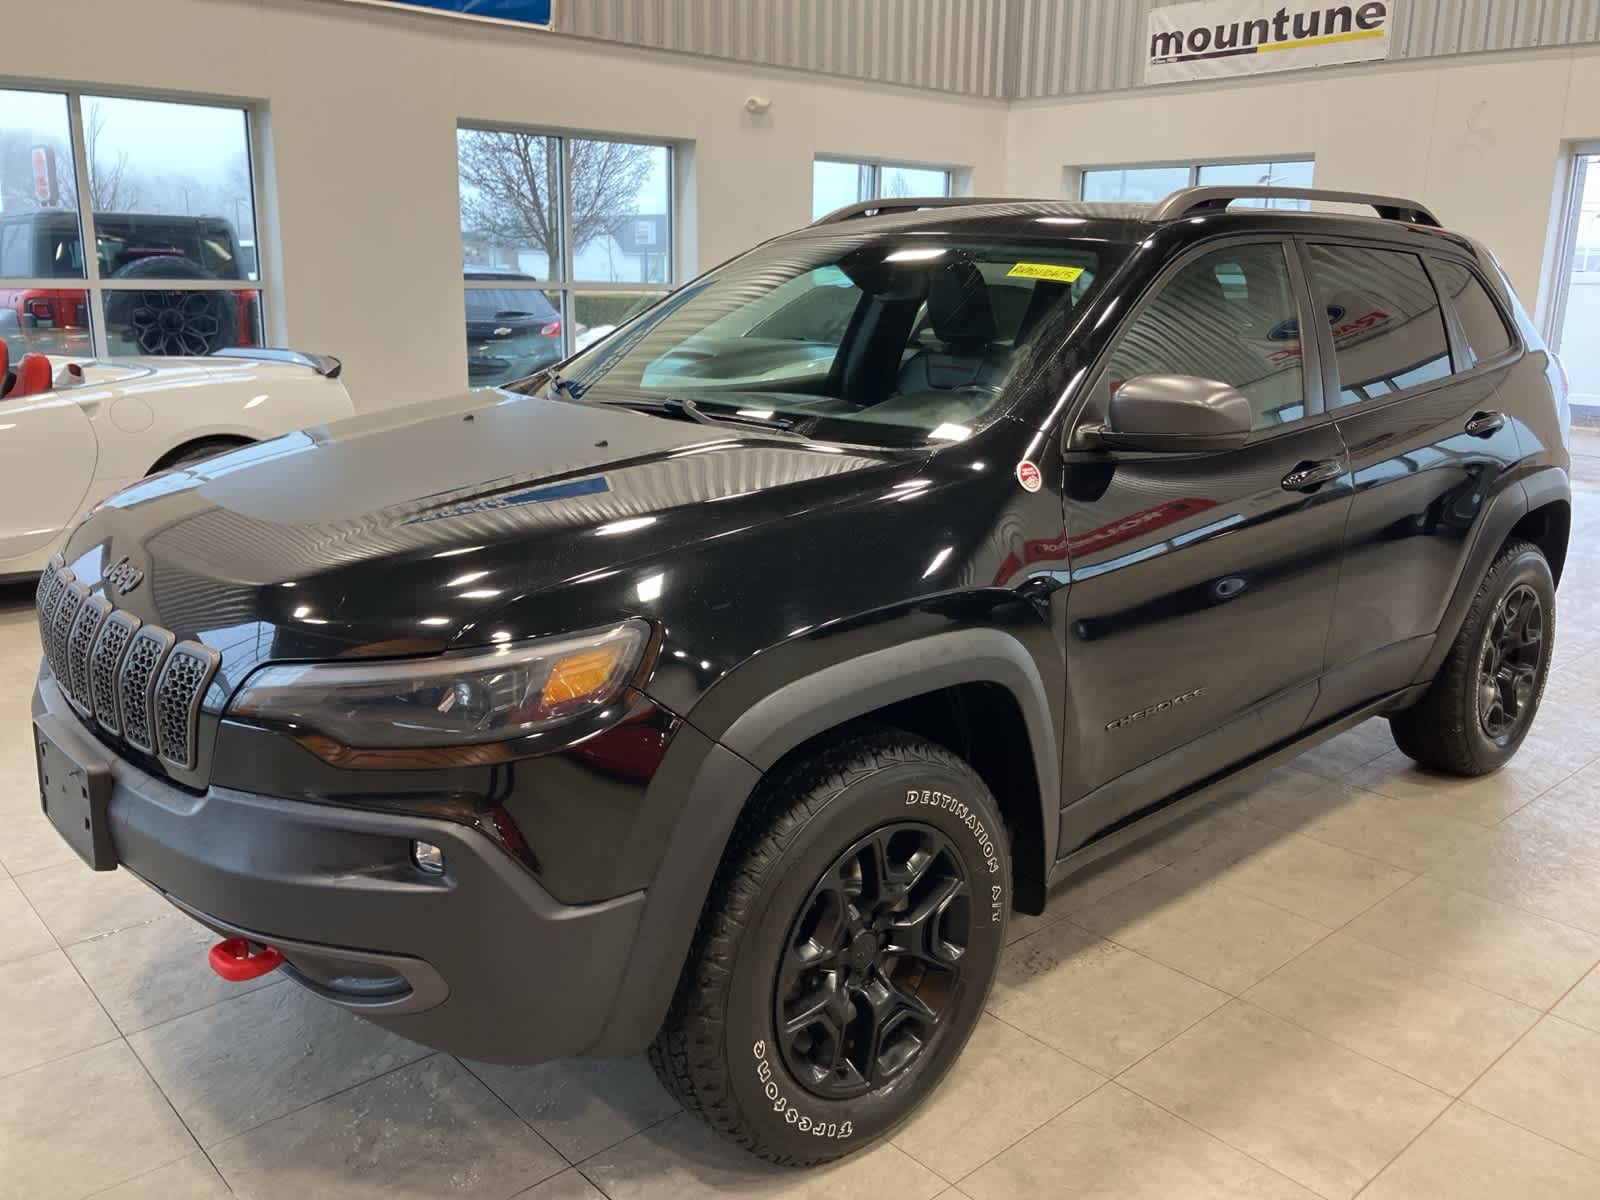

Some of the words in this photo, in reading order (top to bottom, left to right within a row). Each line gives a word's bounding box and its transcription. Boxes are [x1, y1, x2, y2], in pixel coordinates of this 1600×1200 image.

[1151, 2, 1386, 57] mountune
[1105, 687, 1207, 732] CHEROKEE
[905, 790, 999, 873] DESTINATION
[753, 1040, 852, 1138] Firestone
